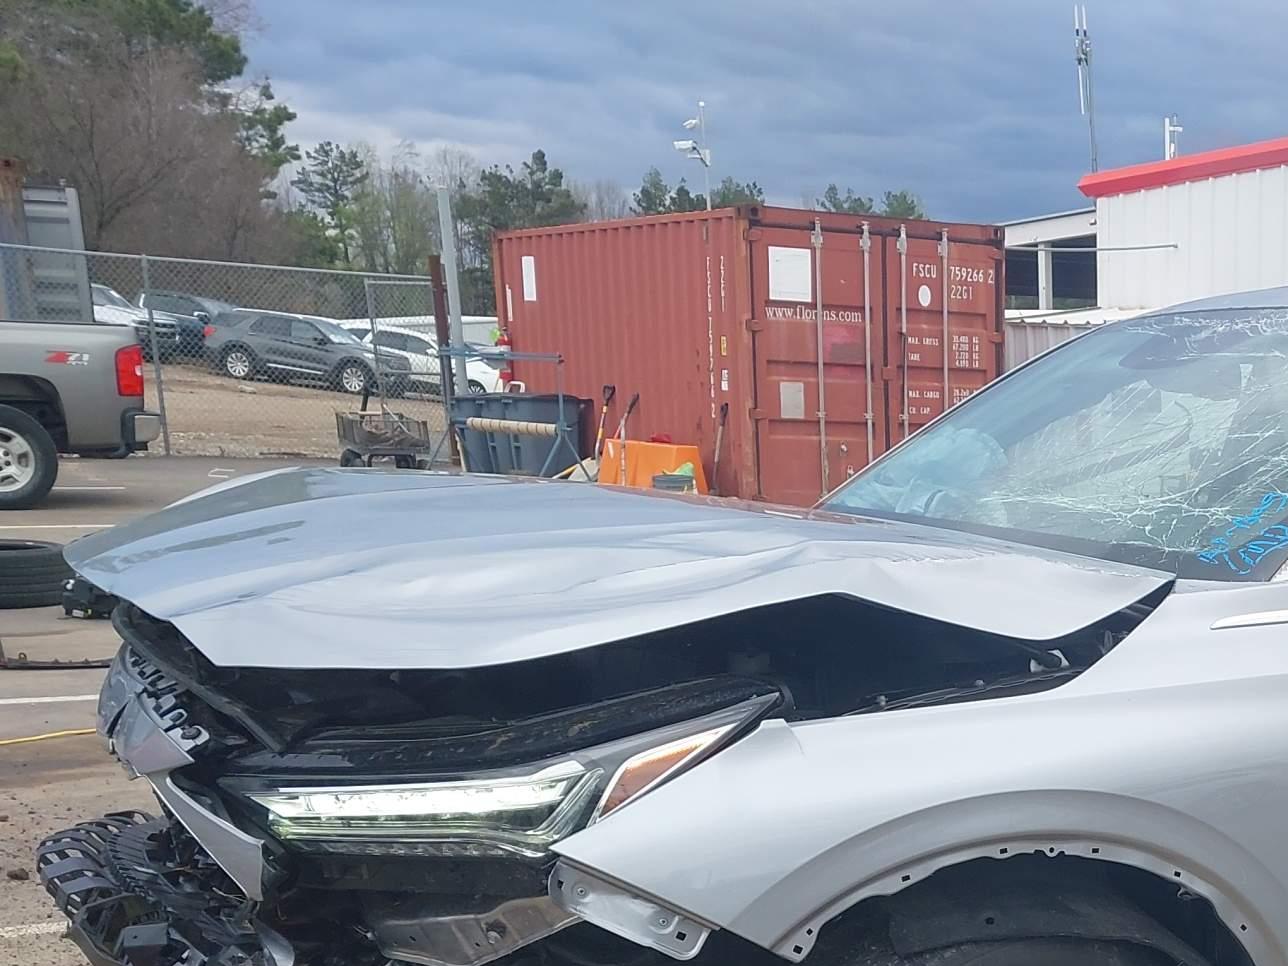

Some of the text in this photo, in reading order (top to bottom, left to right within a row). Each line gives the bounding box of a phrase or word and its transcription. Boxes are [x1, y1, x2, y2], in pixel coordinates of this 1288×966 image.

[912, 262, 995, 284] FSCU 759266 2
[950, 285, 973, 300] 22G1
[765, 304, 863, 322] www.florns.com
